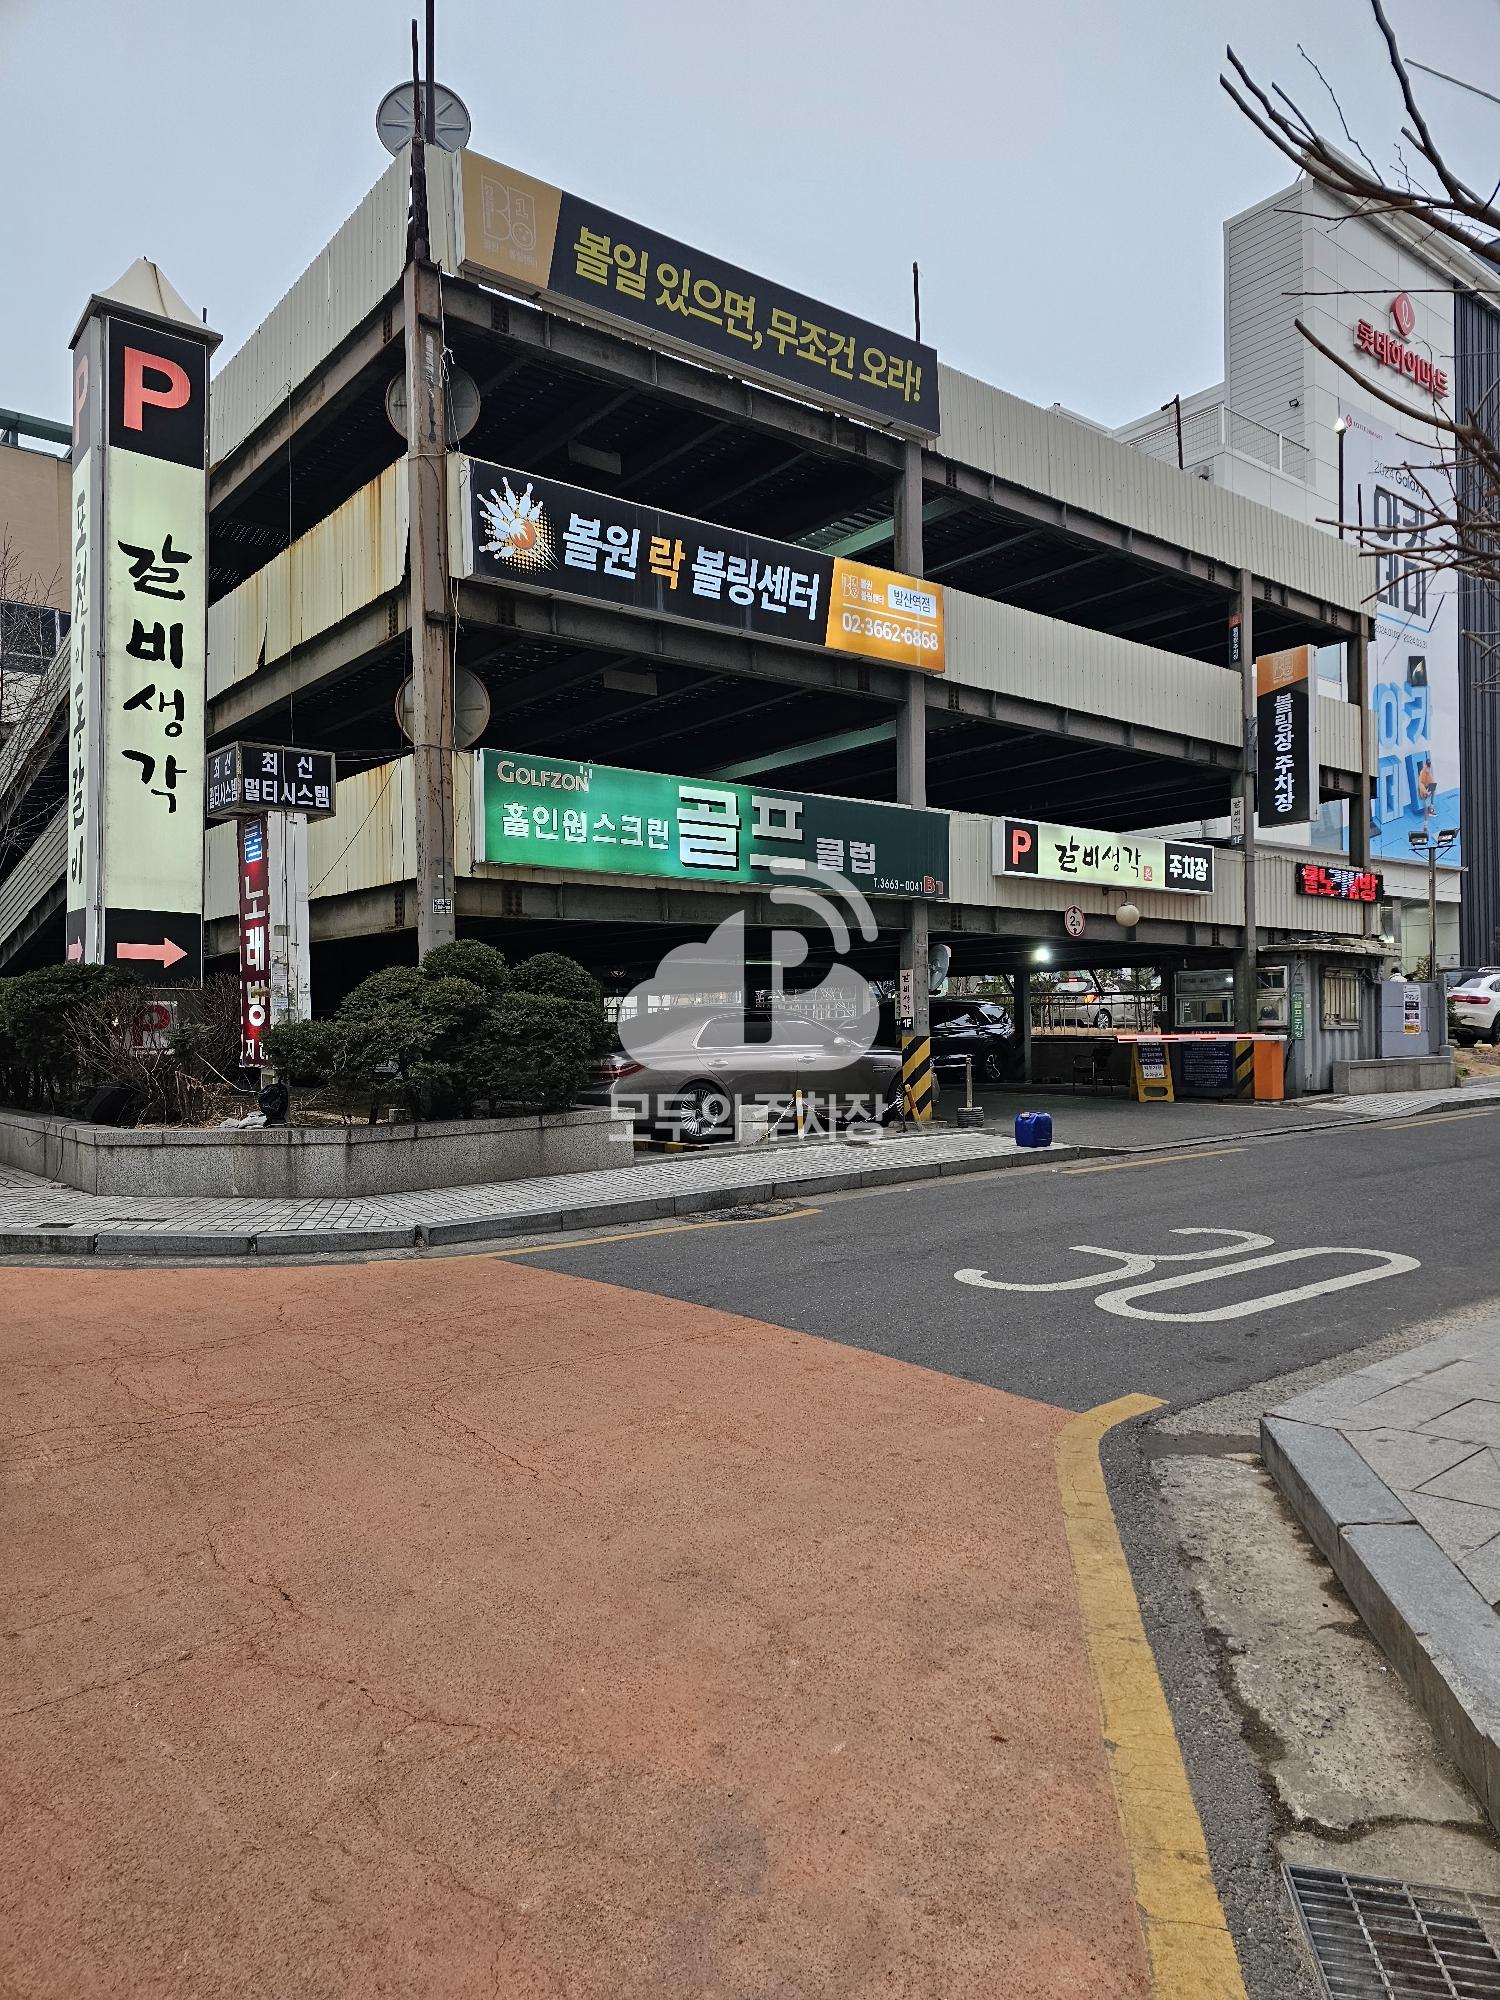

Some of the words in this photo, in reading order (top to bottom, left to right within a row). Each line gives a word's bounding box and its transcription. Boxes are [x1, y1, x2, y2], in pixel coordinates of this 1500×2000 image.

[574, 226, 648, 300] 볼일
[767, 308, 856, 381] 무조건
[858, 346, 922, 402] 오라!
[123, 345, 192, 431] P
[1357, 319, 1449, 398] 롯데하이마트
[1395, 471, 1424, 499] Galaxy
[562, 512, 640, 580] 볼원
[648, 536, 686, 590] 락
[691, 545, 820, 620] 볼링센터
[893, 588, 931, 614] 발산역점
[117, 533, 193, 814] 갈비생각
[1274, 692, 1294, 752] 볼링장
[245, 778, 330, 809] 멀티시스템
[497, 760, 590, 793] GOLFZON
[1274, 754, 1295, 813] 주차장
[676, 785, 806, 871] 골프
[816, 837, 876, 875] 클럽
[1012, 829, 1032, 864] P
[1055, 835, 1141, 878] 갈비생각
[1169, 854, 1208, 882] 주차장
[244, 875, 266, 1027] 노래방
[902, 1018, 912, 1028] 1F
[953, 1227, 1422, 1323] 30
